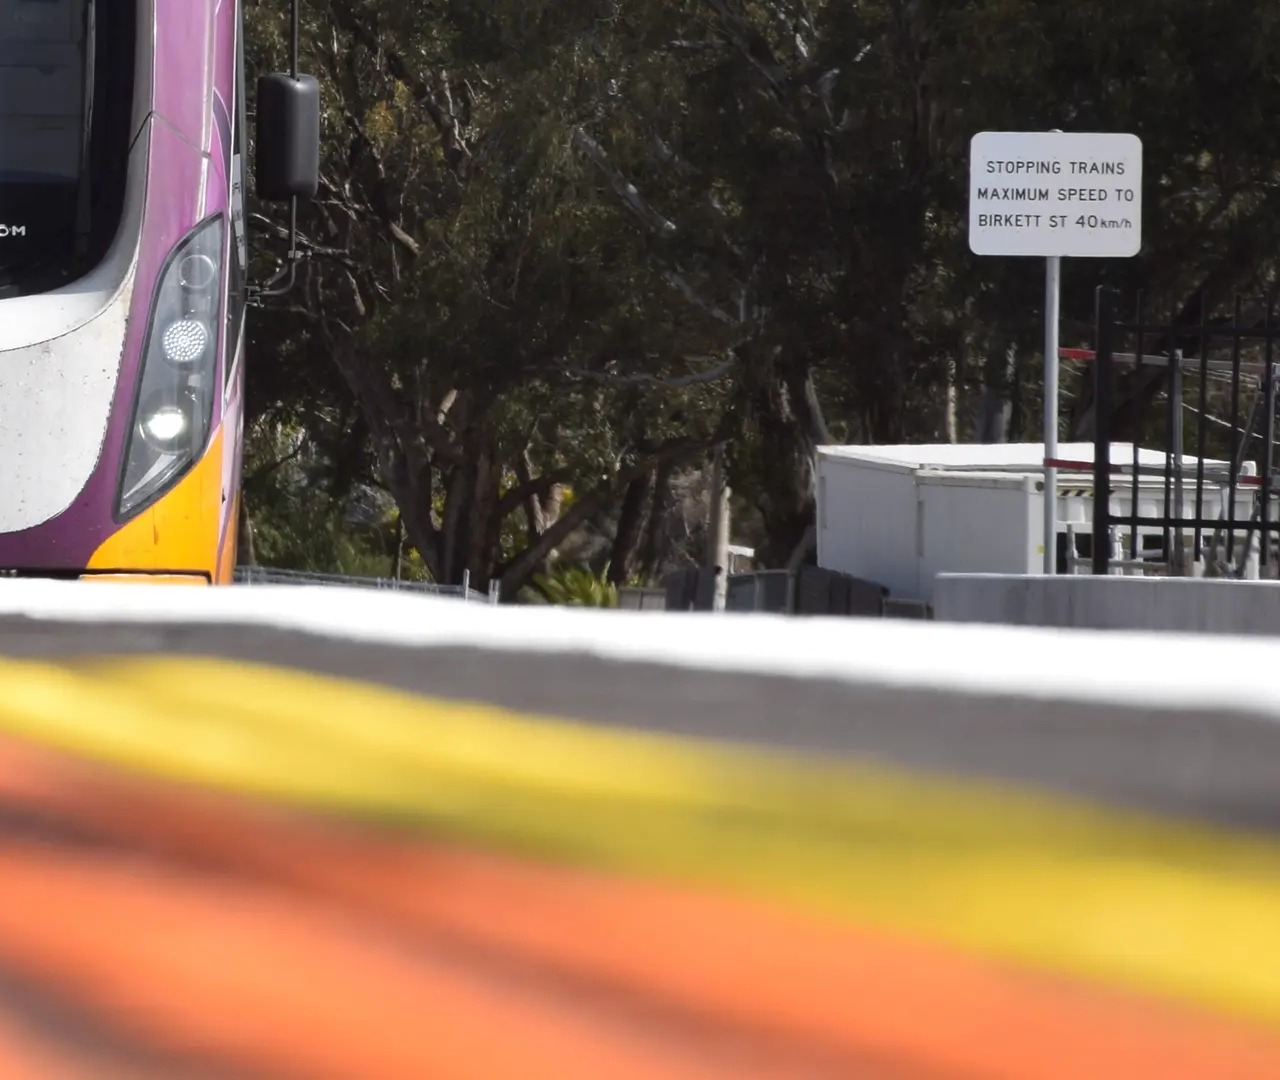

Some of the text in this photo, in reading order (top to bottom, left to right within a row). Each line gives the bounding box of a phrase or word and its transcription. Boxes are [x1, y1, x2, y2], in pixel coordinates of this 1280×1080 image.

[986, 160, 1125, 175] STOPPING TRAINS
[977, 187, 1134, 202] MAXIMUM SPEED TO
[978, 214, 1041, 227] BIRKETT
[1049, 215, 1068, 228] ST
